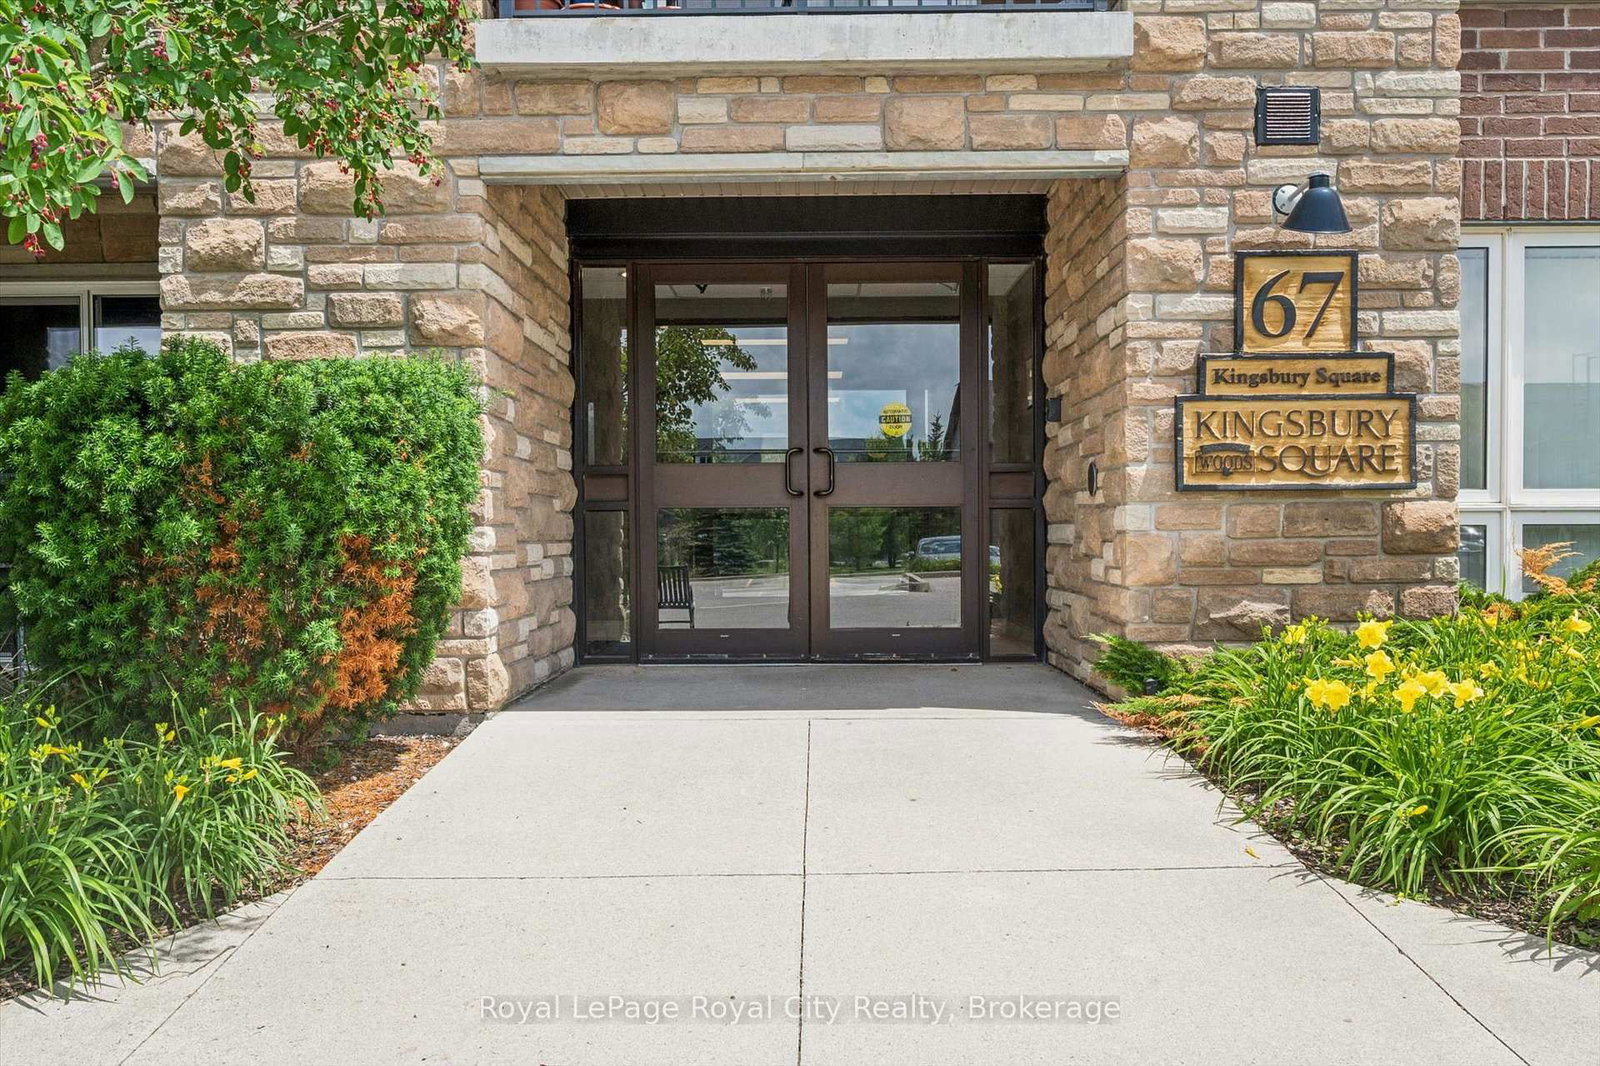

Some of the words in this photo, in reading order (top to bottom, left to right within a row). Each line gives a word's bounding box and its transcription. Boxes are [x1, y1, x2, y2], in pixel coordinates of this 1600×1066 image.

[1251, 269, 1345, 340] 67
[1212, 367, 1310, 388] Kingsbury
[1315, 367, 1382, 388] Square
[881, 415, 911, 423] CAUTION
[1194, 409, 1399, 440] KINGSBURY
[1199, 454, 1253, 471] WOODS
[1258, 444, 1399, 477] SQUARE
